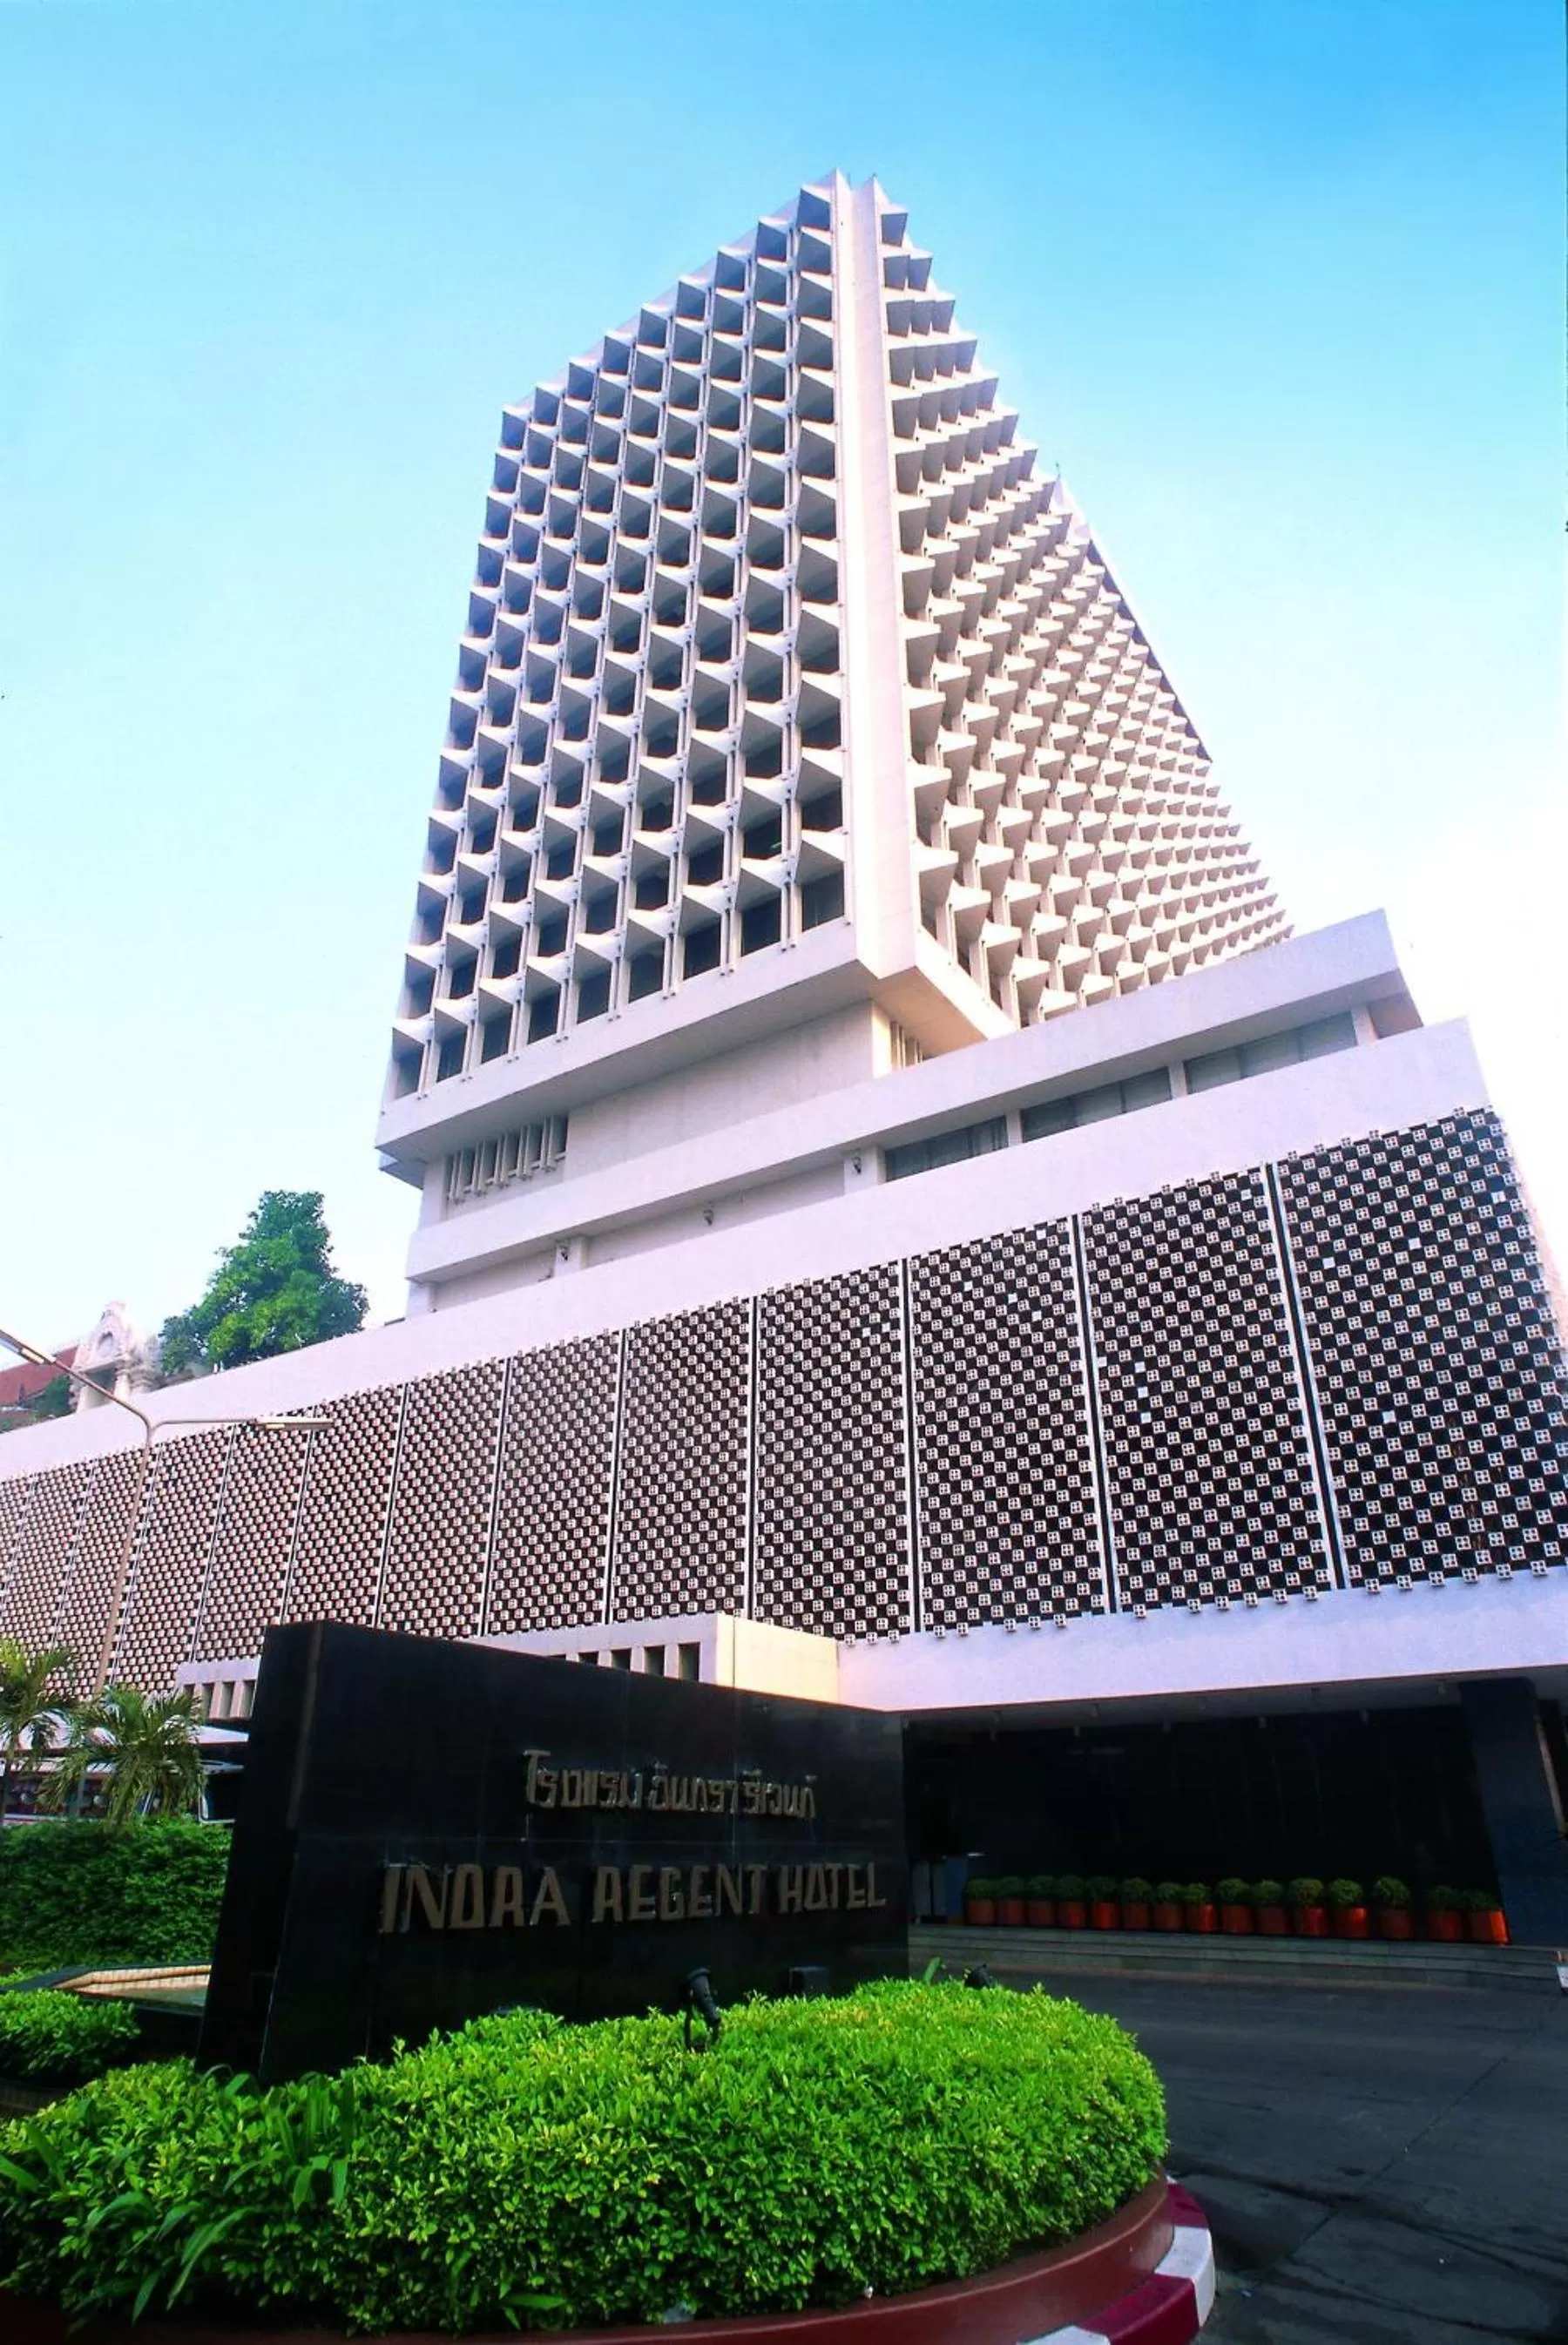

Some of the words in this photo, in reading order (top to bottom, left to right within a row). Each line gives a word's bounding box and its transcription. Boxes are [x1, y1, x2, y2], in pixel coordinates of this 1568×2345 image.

[522, 1747, 643, 1810] โรงแรม
[377, 1862, 571, 1935] INDRA
[590, 1862, 768, 1924] REGENT
[776, 1862, 888, 1912] HOTEL
